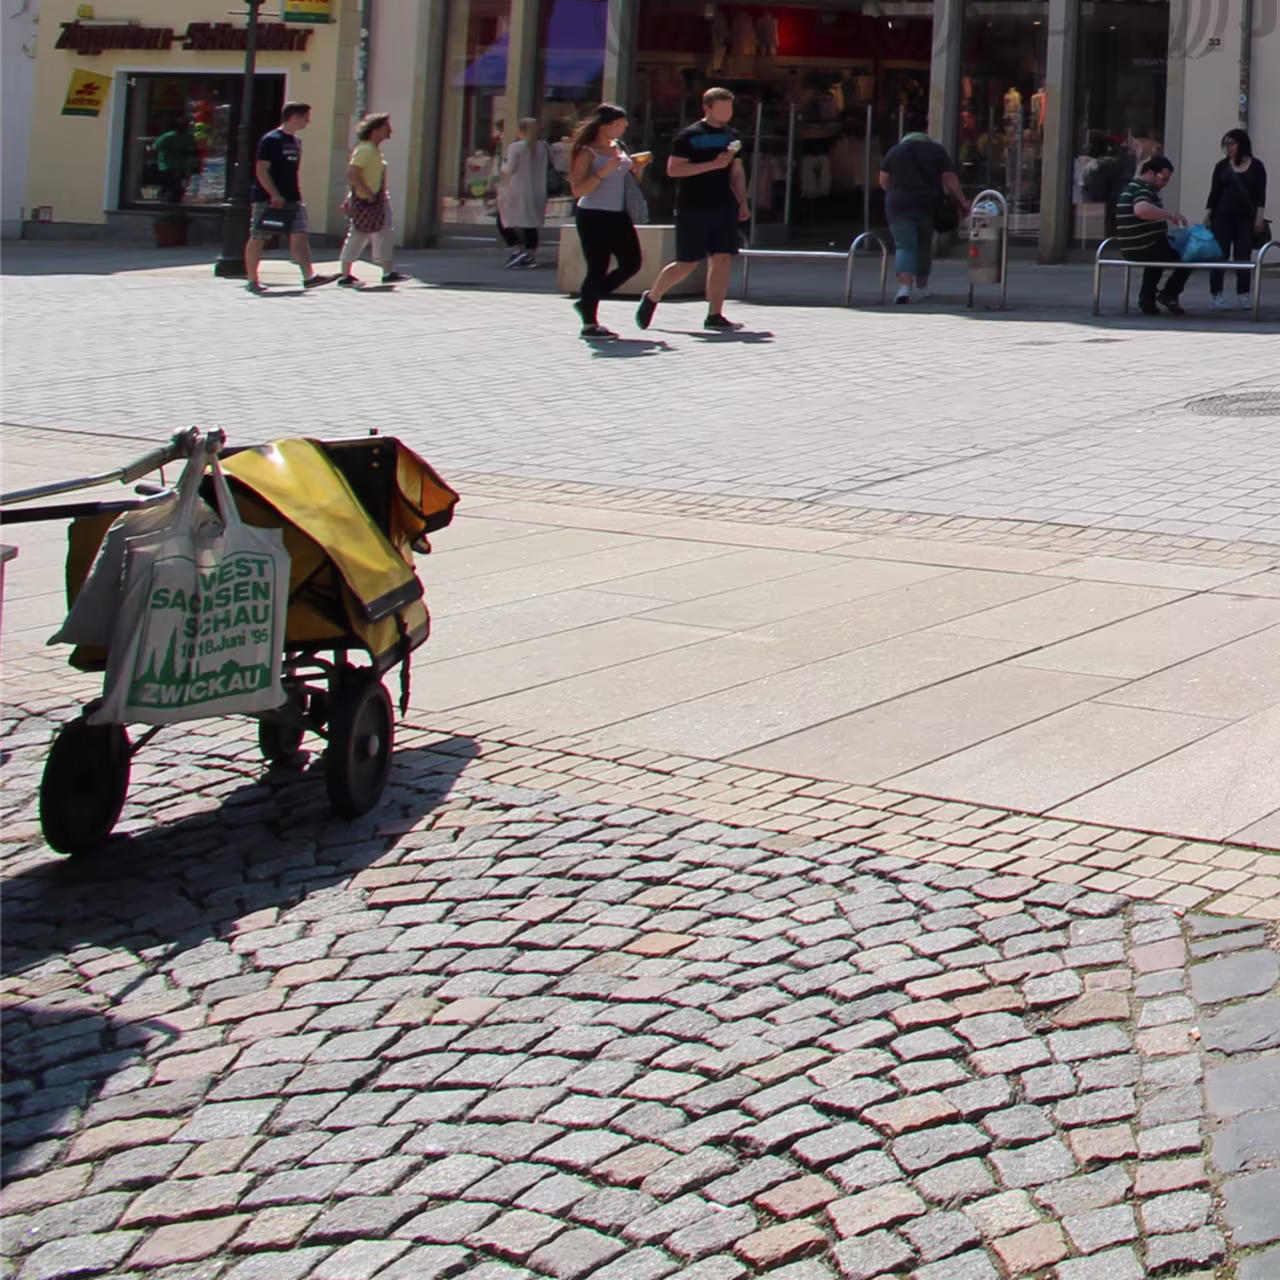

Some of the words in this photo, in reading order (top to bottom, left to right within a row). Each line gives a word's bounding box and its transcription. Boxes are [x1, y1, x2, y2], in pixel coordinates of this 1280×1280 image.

[150, 581, 270, 615] SACHSEN
[183, 604, 270, 639] SCHAU
[141, 669, 261, 705] ZWICKAU
